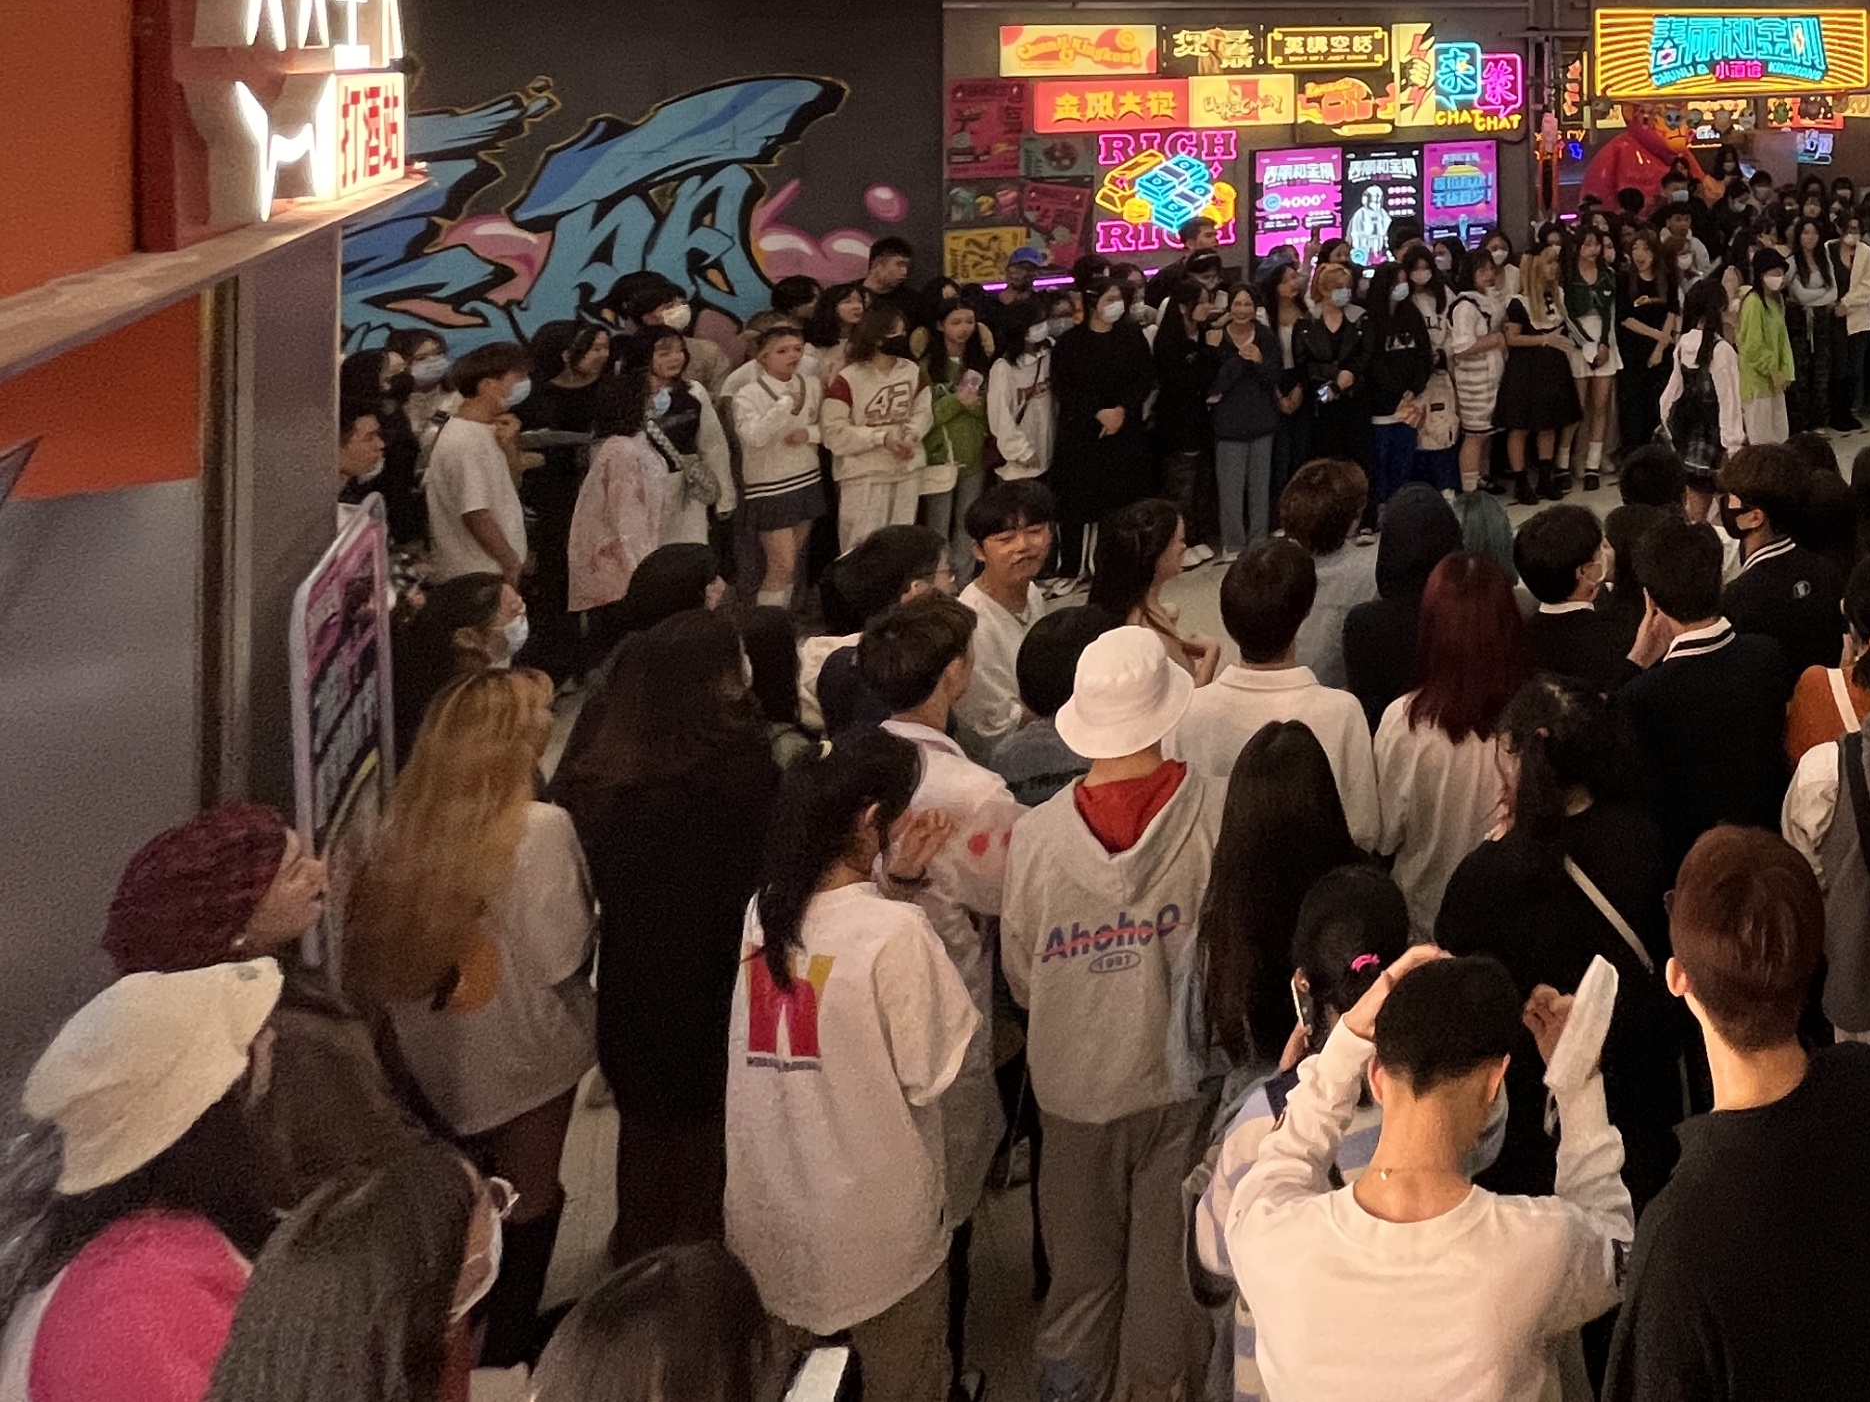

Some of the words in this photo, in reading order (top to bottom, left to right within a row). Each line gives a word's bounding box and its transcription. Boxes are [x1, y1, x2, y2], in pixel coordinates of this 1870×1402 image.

[1714, 60, 1763, 79] 小酒馆
[1435, 109, 1484, 126] CHAT
[1473, 113, 1522, 132] CHAT
